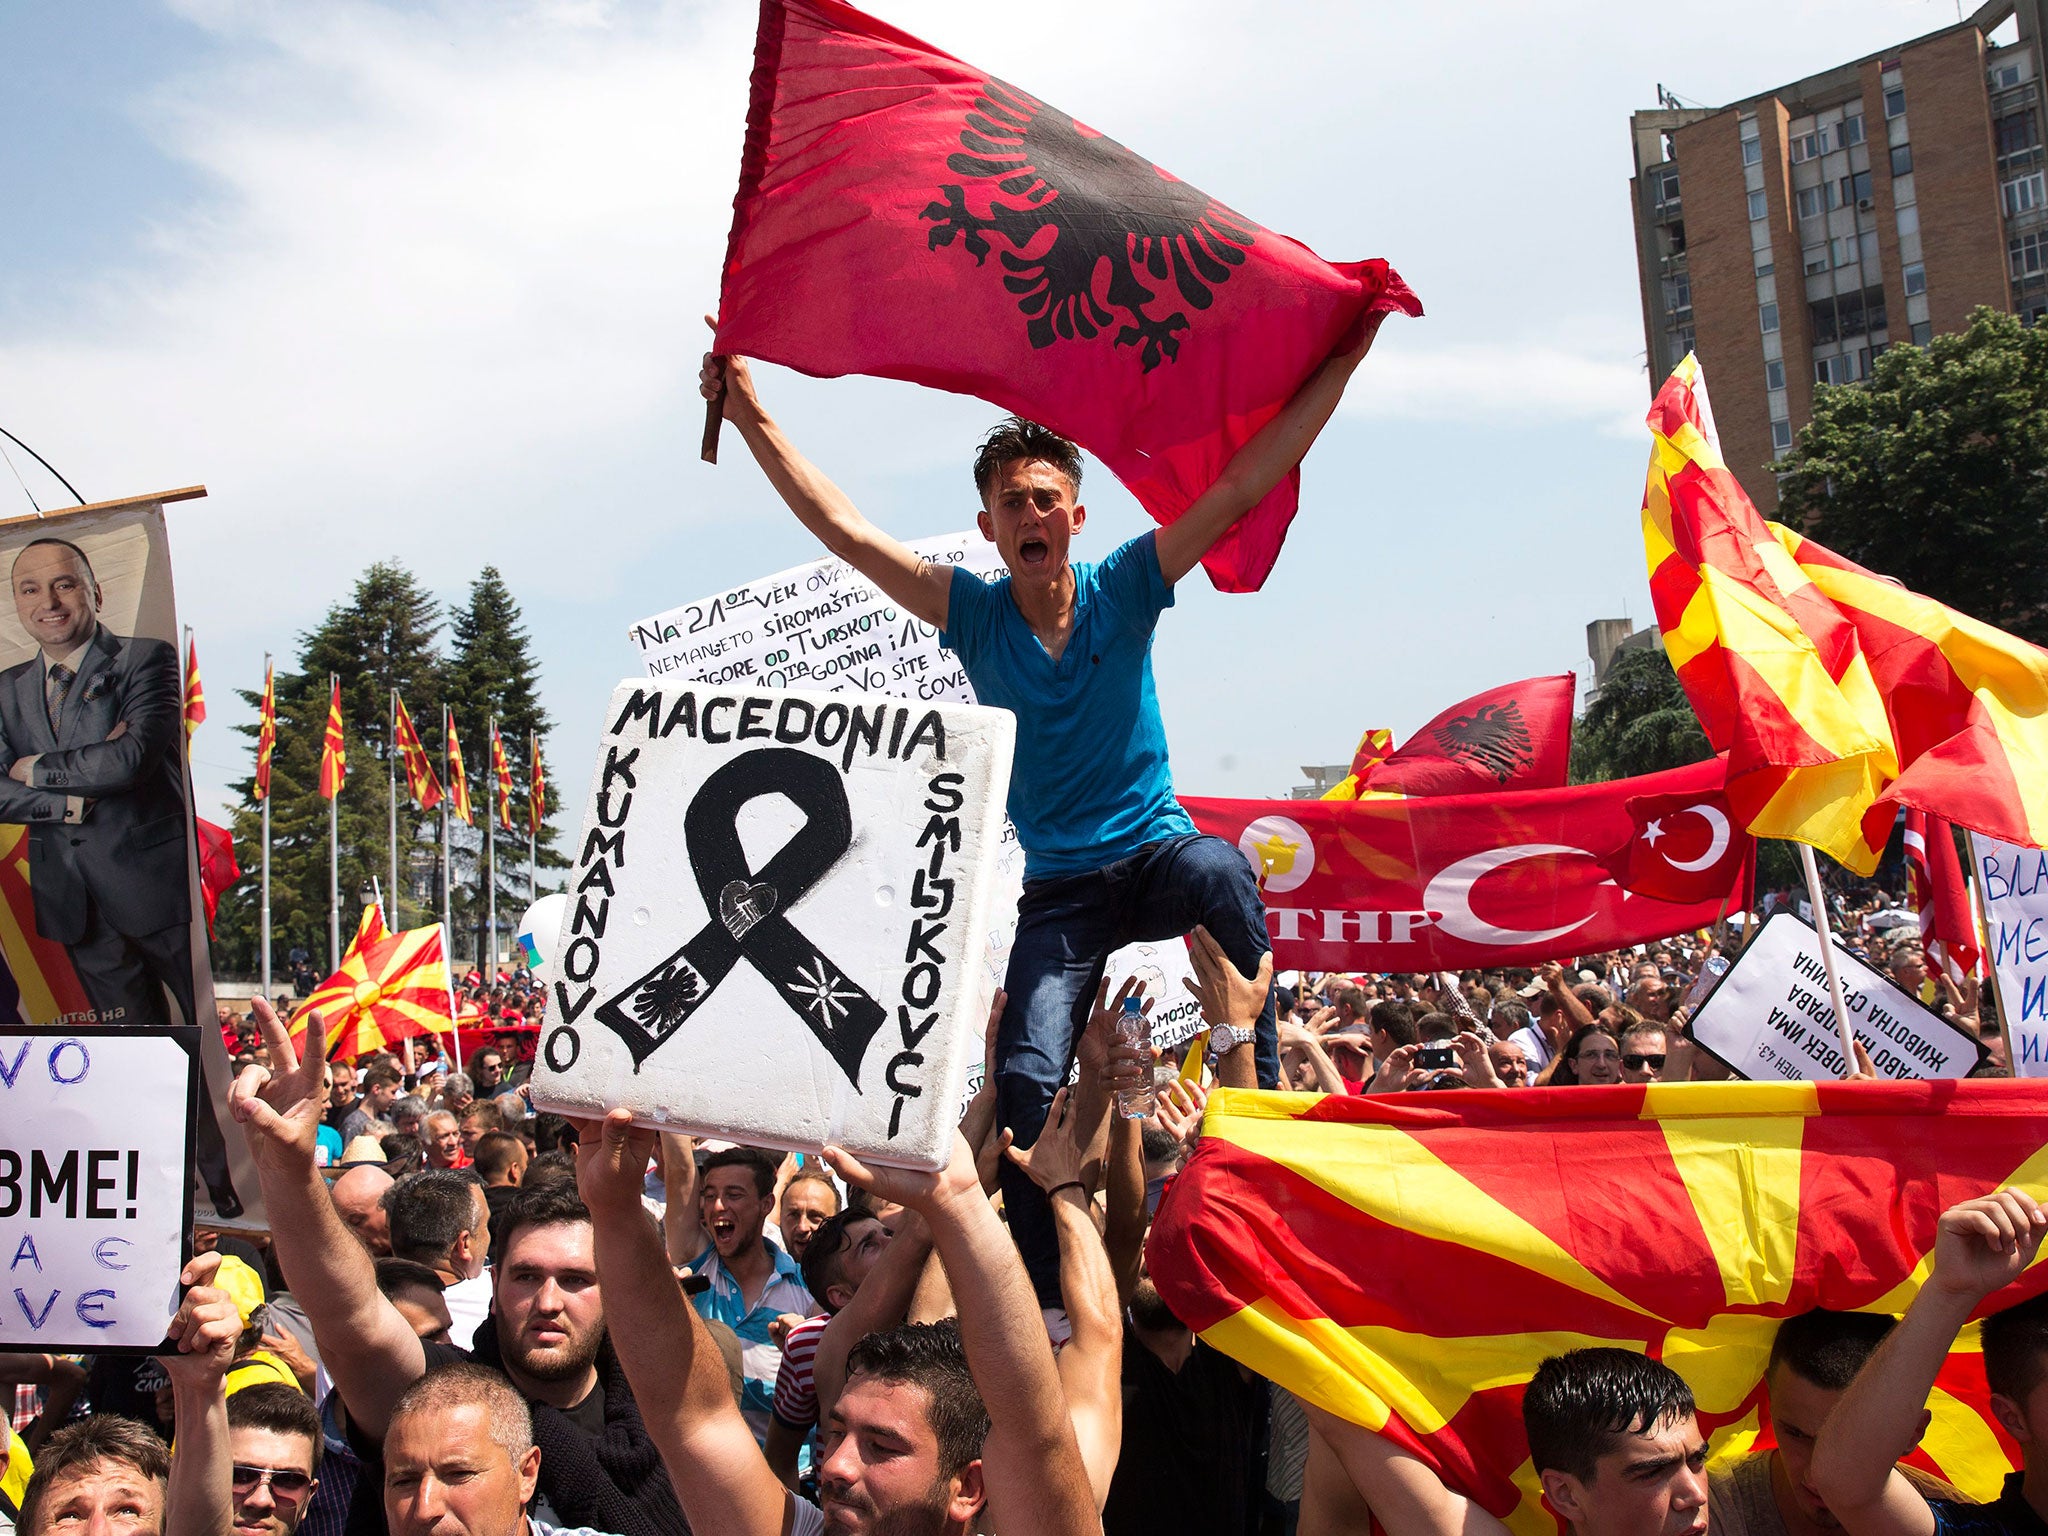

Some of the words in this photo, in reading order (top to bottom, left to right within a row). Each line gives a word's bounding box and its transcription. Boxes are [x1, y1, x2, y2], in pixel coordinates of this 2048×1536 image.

[753, 582, 798, 608] VEK
[764, 649, 790, 667] OD
[845, 666, 886, 692] VO
[610, 689, 946, 773] MACEDONIA
[545, 745, 640, 1074] KUMANOVO
[1265, 906, 1443, 944] THP
[101, 1006, 126, 1022] на
[1767, 1006, 1809, 1045] ИМА
[1800, 1032, 1848, 1077] ОВЕК
[1866, 1003, 1949, 1073] ЖИВОТНА
